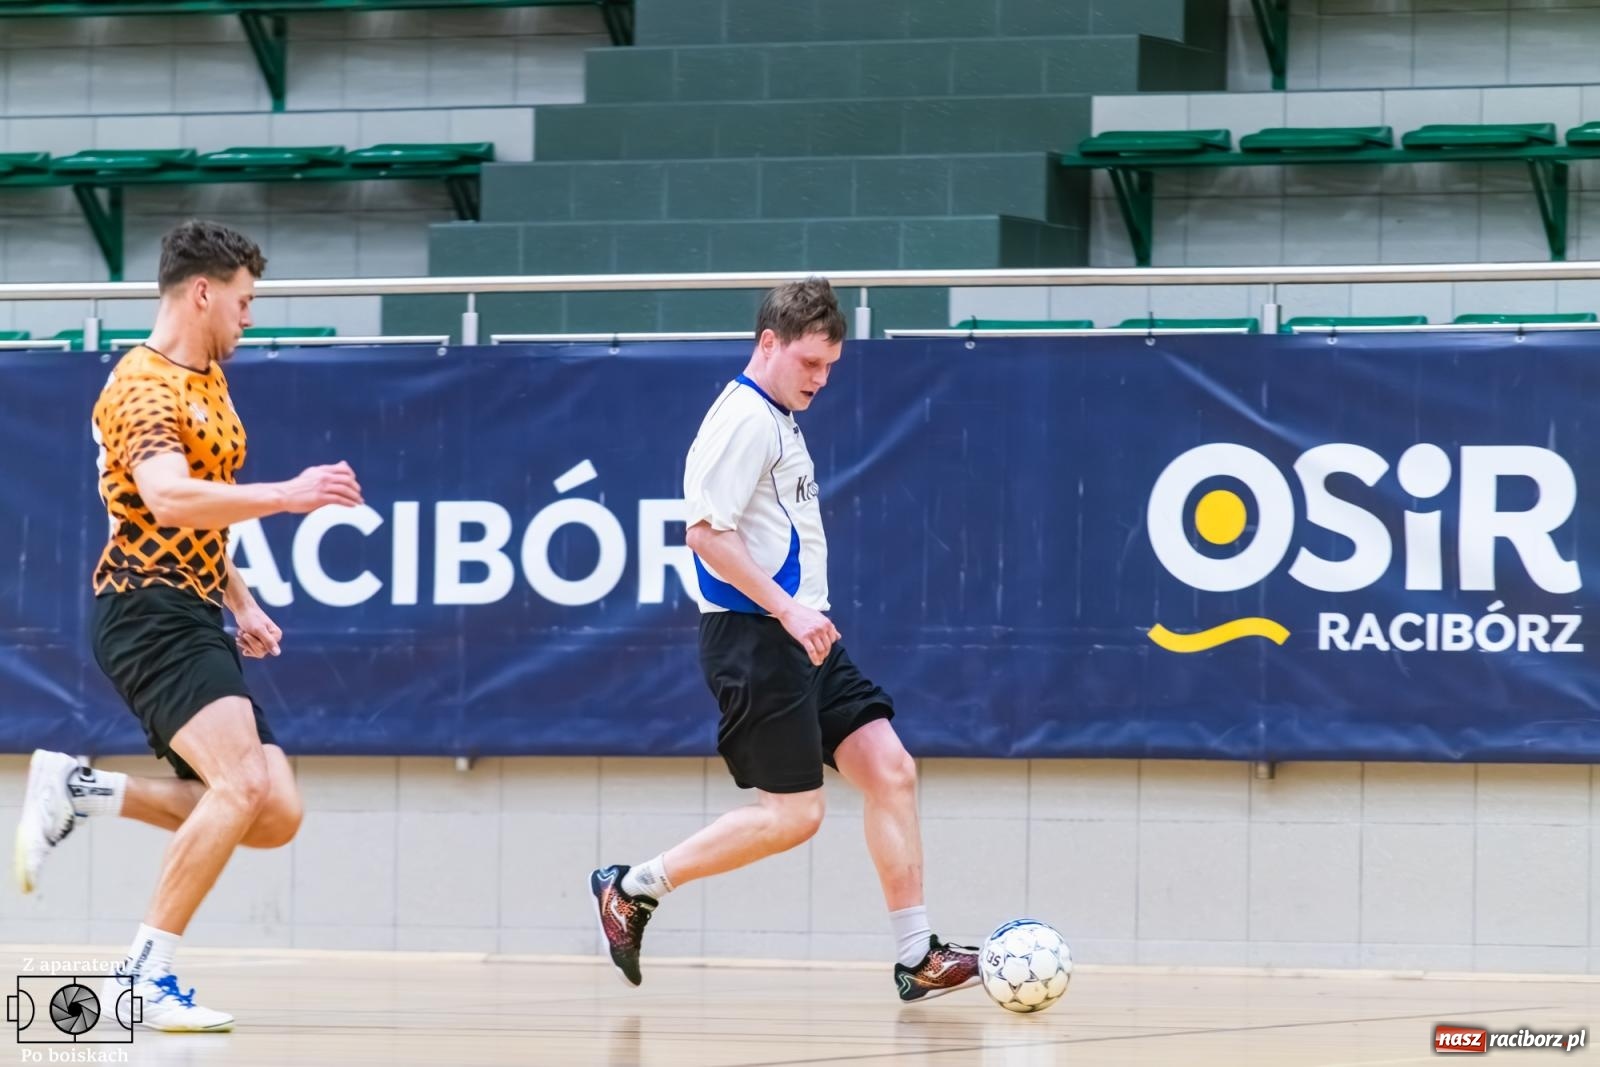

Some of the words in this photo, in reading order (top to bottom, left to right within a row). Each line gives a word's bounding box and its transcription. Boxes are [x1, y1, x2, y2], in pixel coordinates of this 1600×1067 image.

[225, 459, 699, 607] ACIBÓR
[1147, 443, 1583, 593] OSiR
[1318, 600, 1584, 652] RACIBÓRZ
